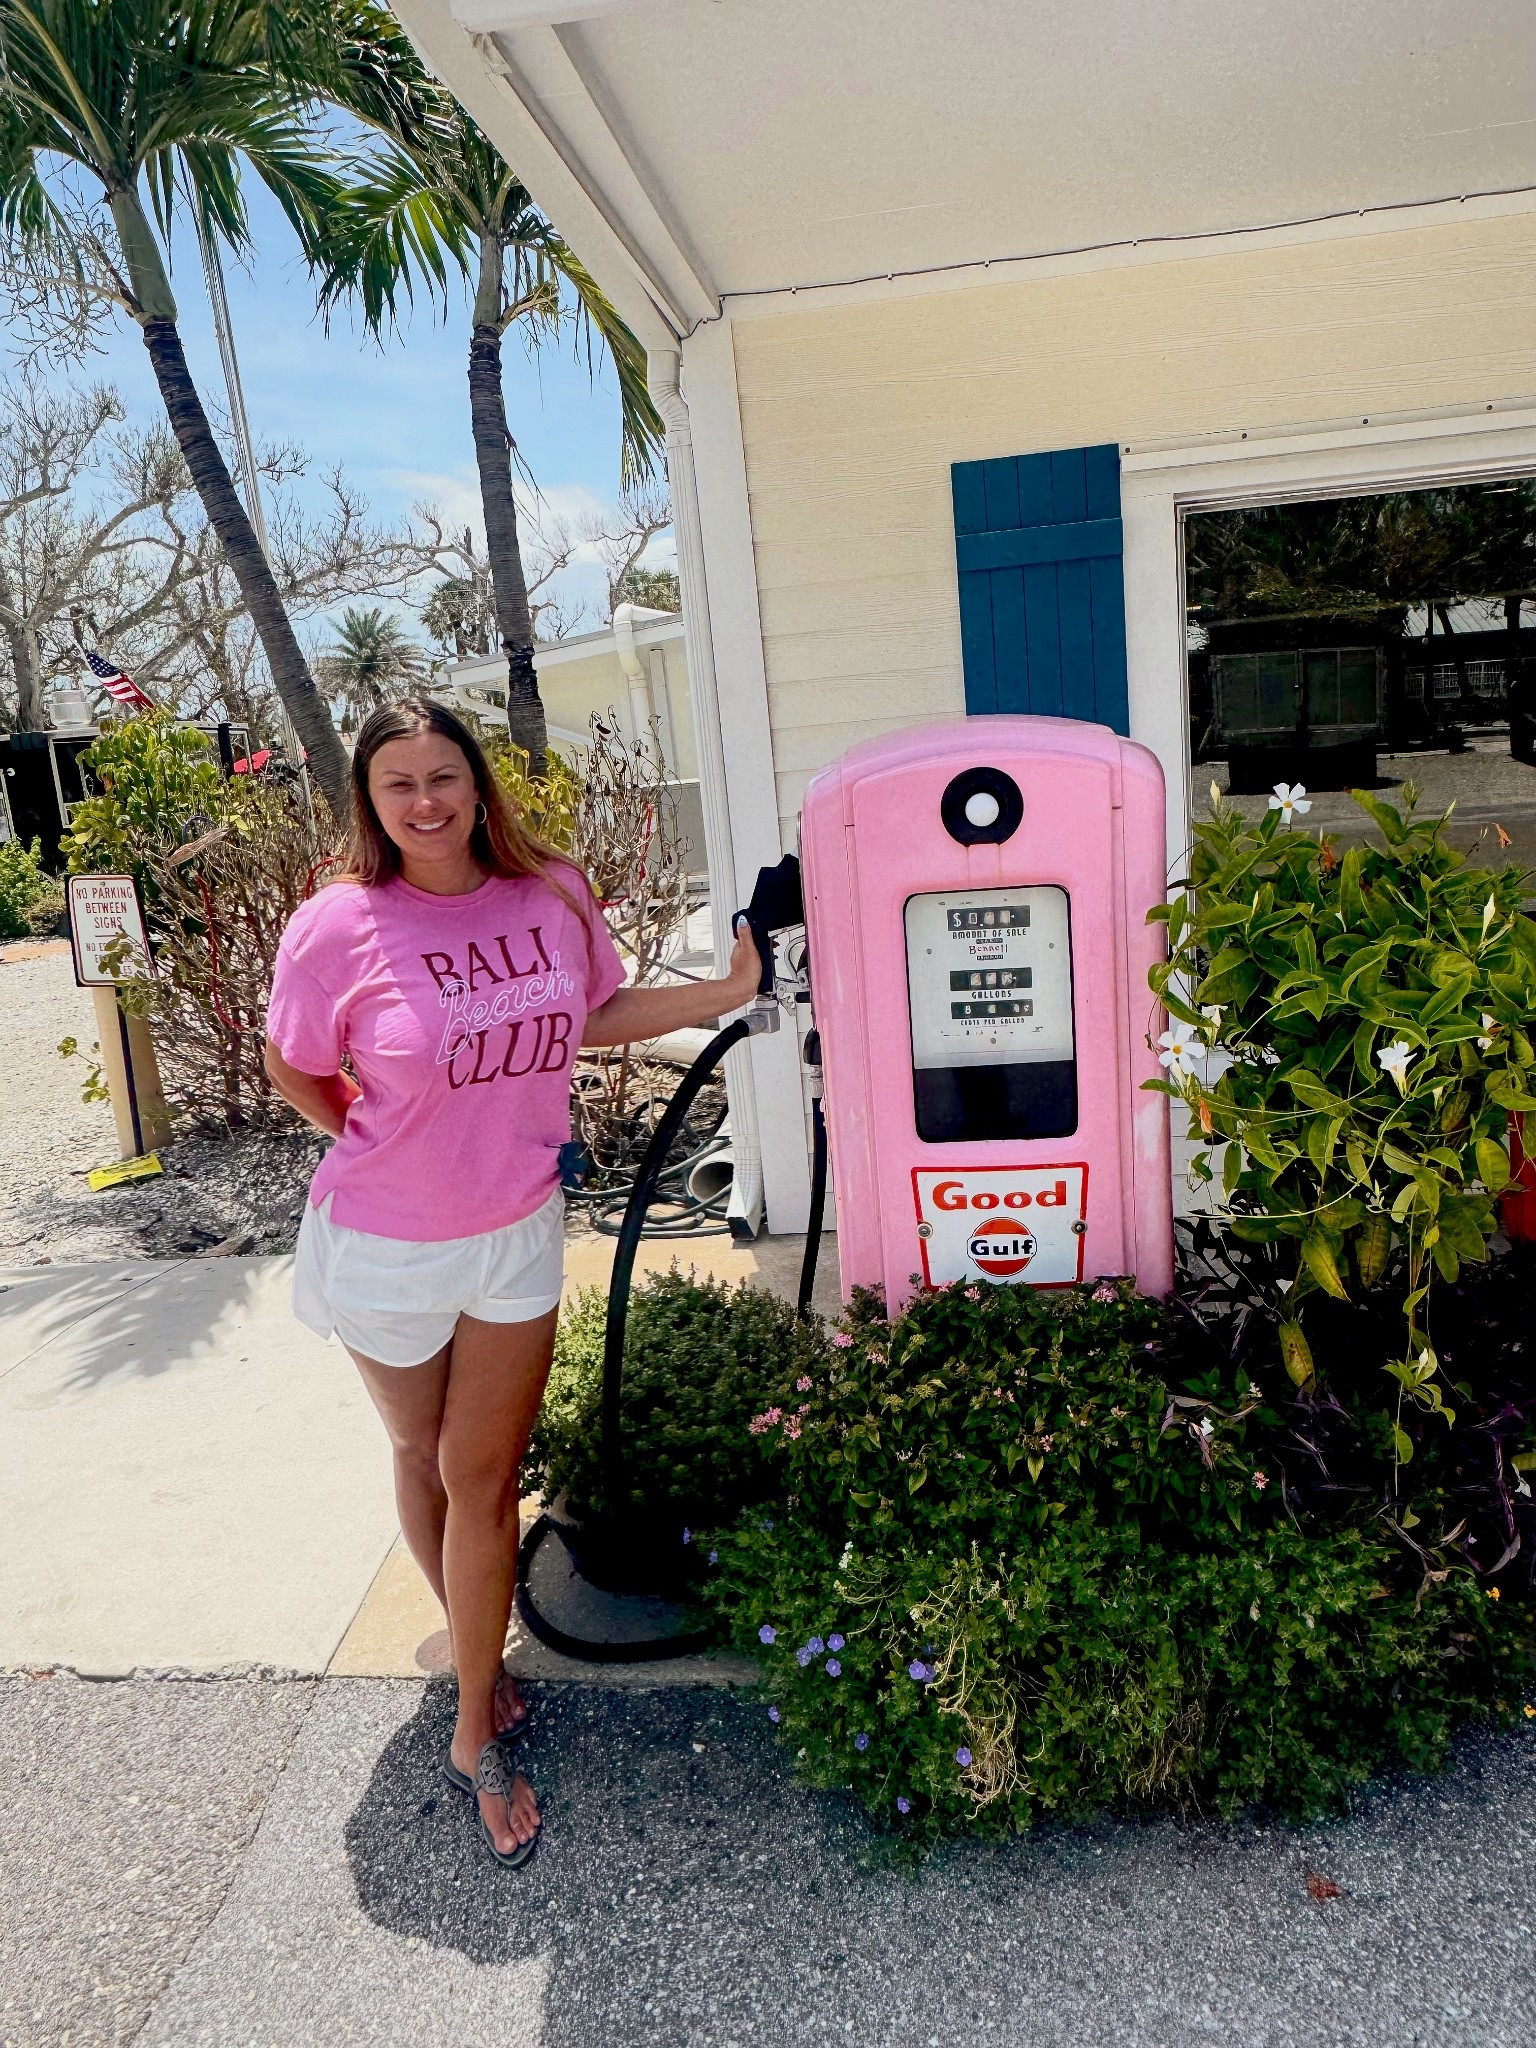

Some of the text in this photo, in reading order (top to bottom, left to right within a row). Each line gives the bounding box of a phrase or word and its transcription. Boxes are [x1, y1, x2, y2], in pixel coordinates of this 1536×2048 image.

[76, 887, 133, 899] NO PARKING
[85, 902, 127, 914] BETWEEN
[94, 916, 123, 929] SIGNS
[952, 928, 1027, 939] AMOUNT OF SALE
[420, 926, 557, 997] BALI
[971, 990, 1012, 999] GALLONS
[436, 951, 574, 1065] Beach
[447, 1012, 573, 1090] CLUB
[932, 1180, 1067, 1211] Good
[970, 1239, 1034, 1256] Gulf
